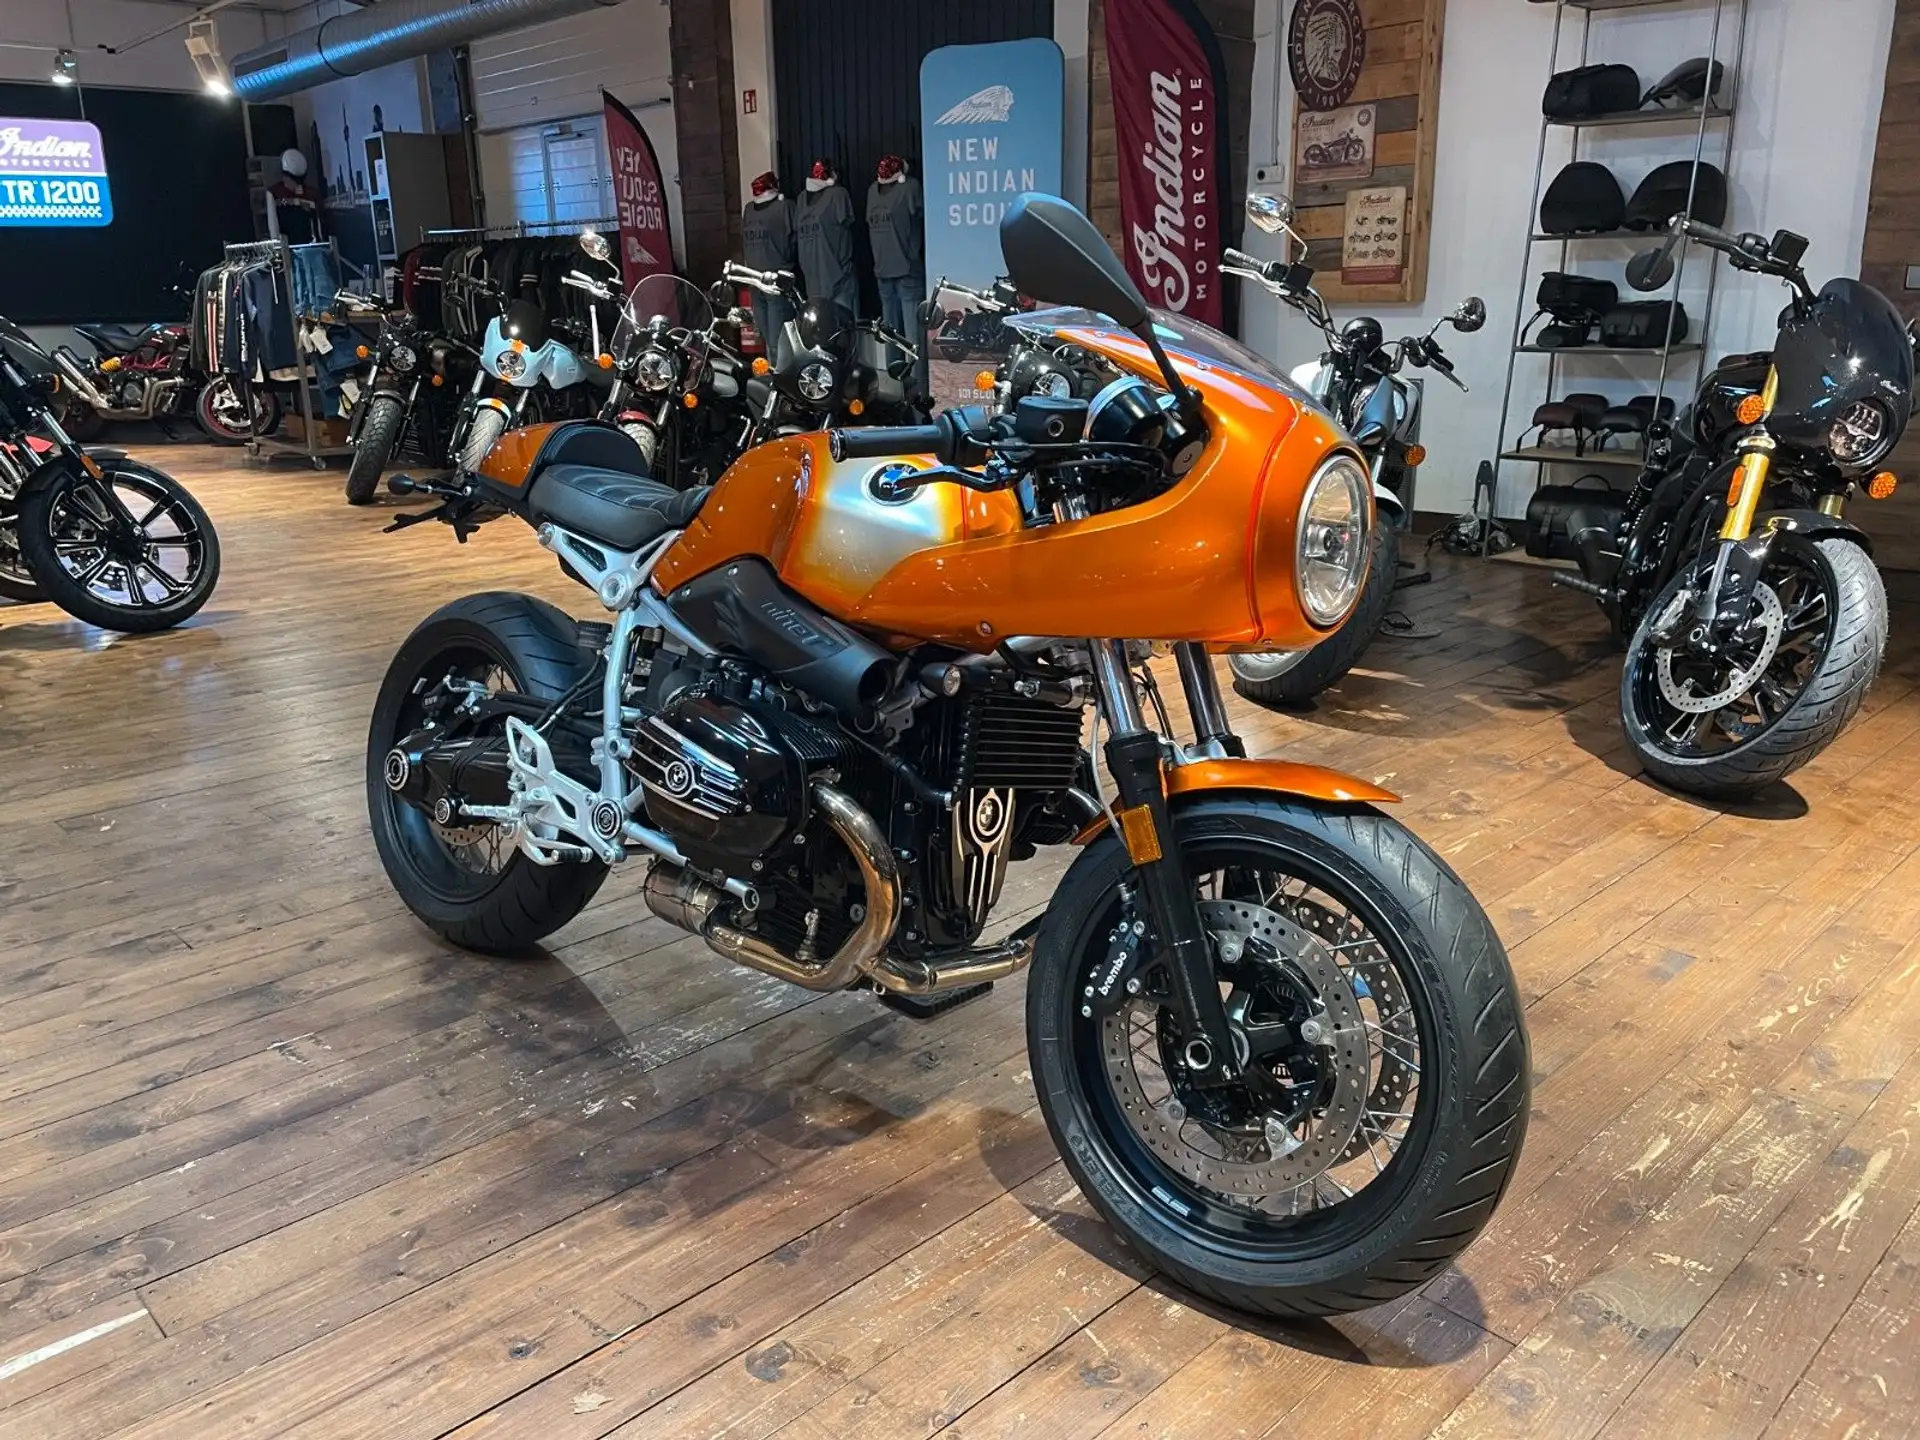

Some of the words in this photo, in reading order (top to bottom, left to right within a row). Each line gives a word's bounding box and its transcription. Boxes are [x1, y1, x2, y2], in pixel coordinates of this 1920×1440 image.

[0, 127, 92, 158] Indian
[948, 137, 998, 163] NEW
[0, 158, 90, 168] OTORCYCLE
[0, 180, 36, 204] TR
[41, 180, 100, 204] 1200
[948, 168, 1035, 195] INDIAN
[1132, 70, 1190, 312] Indian
[1190, 78, 1207, 300] MOTORCYCLE
[949, 202, 1012, 226] SCO
[973, 388, 996, 400] SCO
[1098, 951, 1127, 996] brembo
